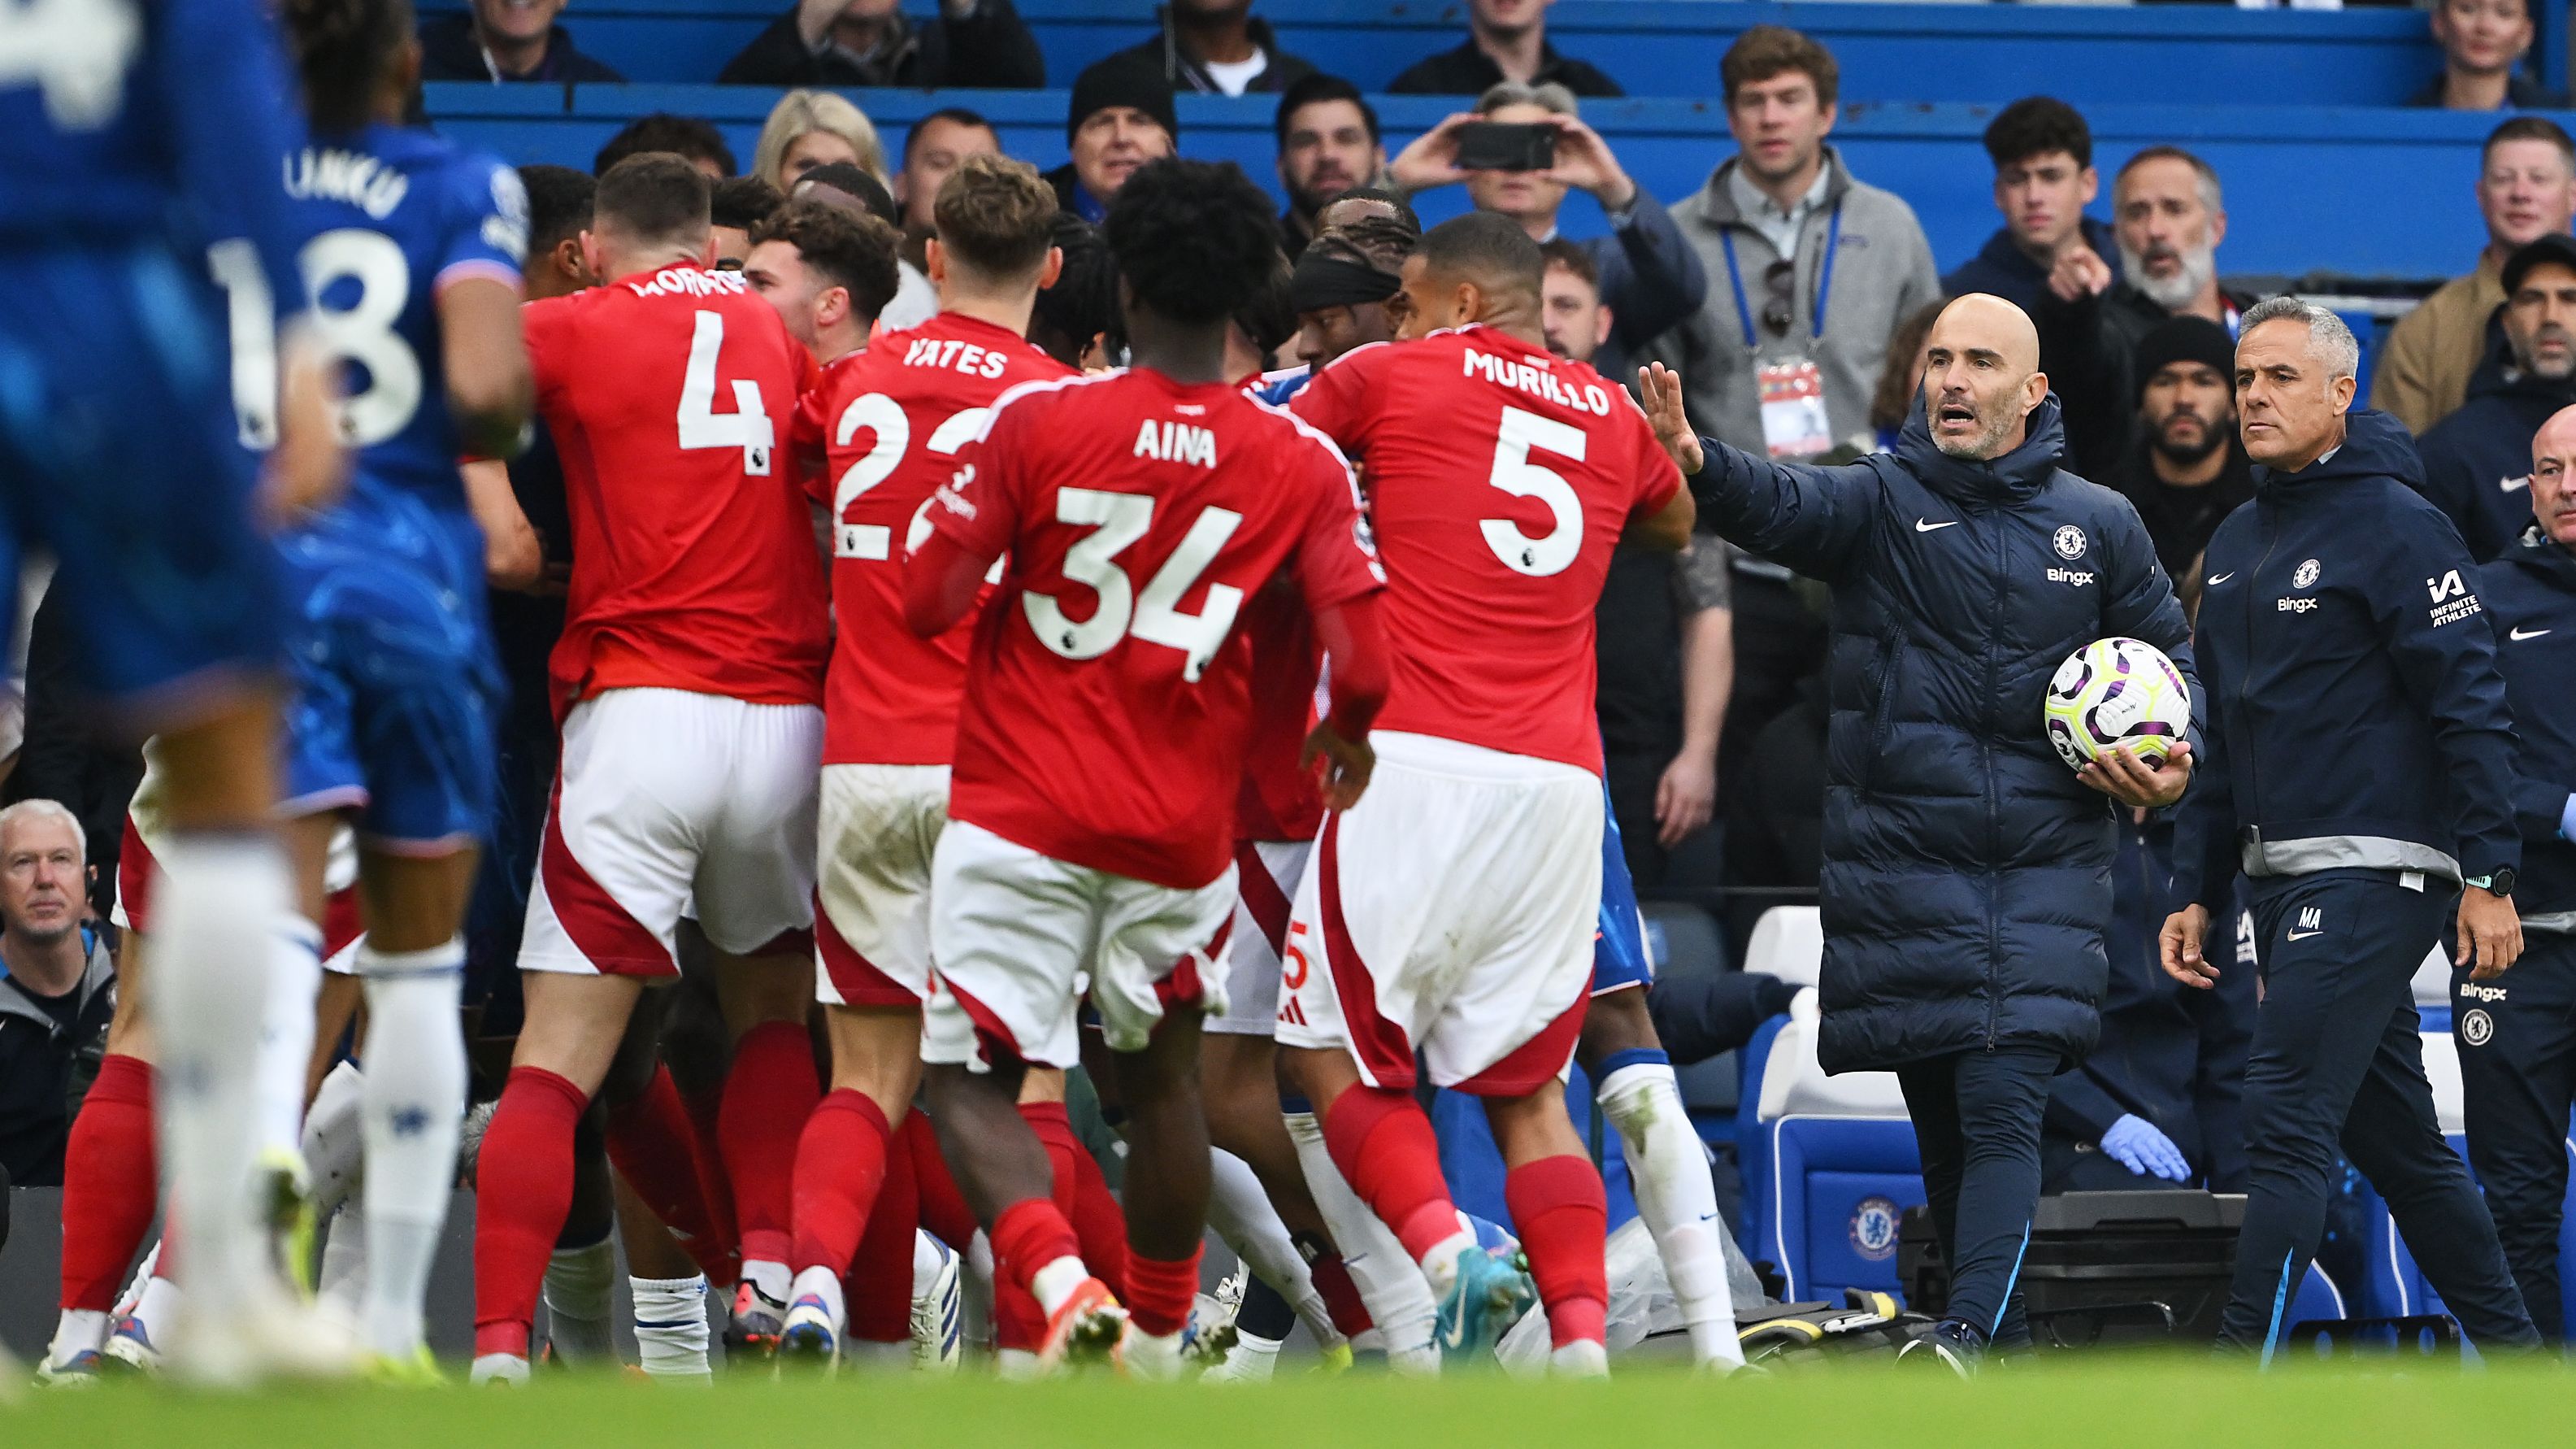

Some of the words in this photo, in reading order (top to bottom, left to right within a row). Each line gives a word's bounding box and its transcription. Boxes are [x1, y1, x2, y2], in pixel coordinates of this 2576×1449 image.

[206, 228, 423, 450] 18
[903, 337, 1008, 379] YATES
[677, 310, 775, 476] 4
[1464, 348, 1609, 416] MURILLO
[1132, 418, 1217, 469] AINA
[1479, 405, 1586, 577] 5
[1022, 486, 1244, 683] 34
[2430, 594, 2478, 619] INFINITE
[2433, 603, 2482, 628] ATHLETE
[2298, 907, 2322, 929] MA
[1283, 920, 1308, 990] 5
